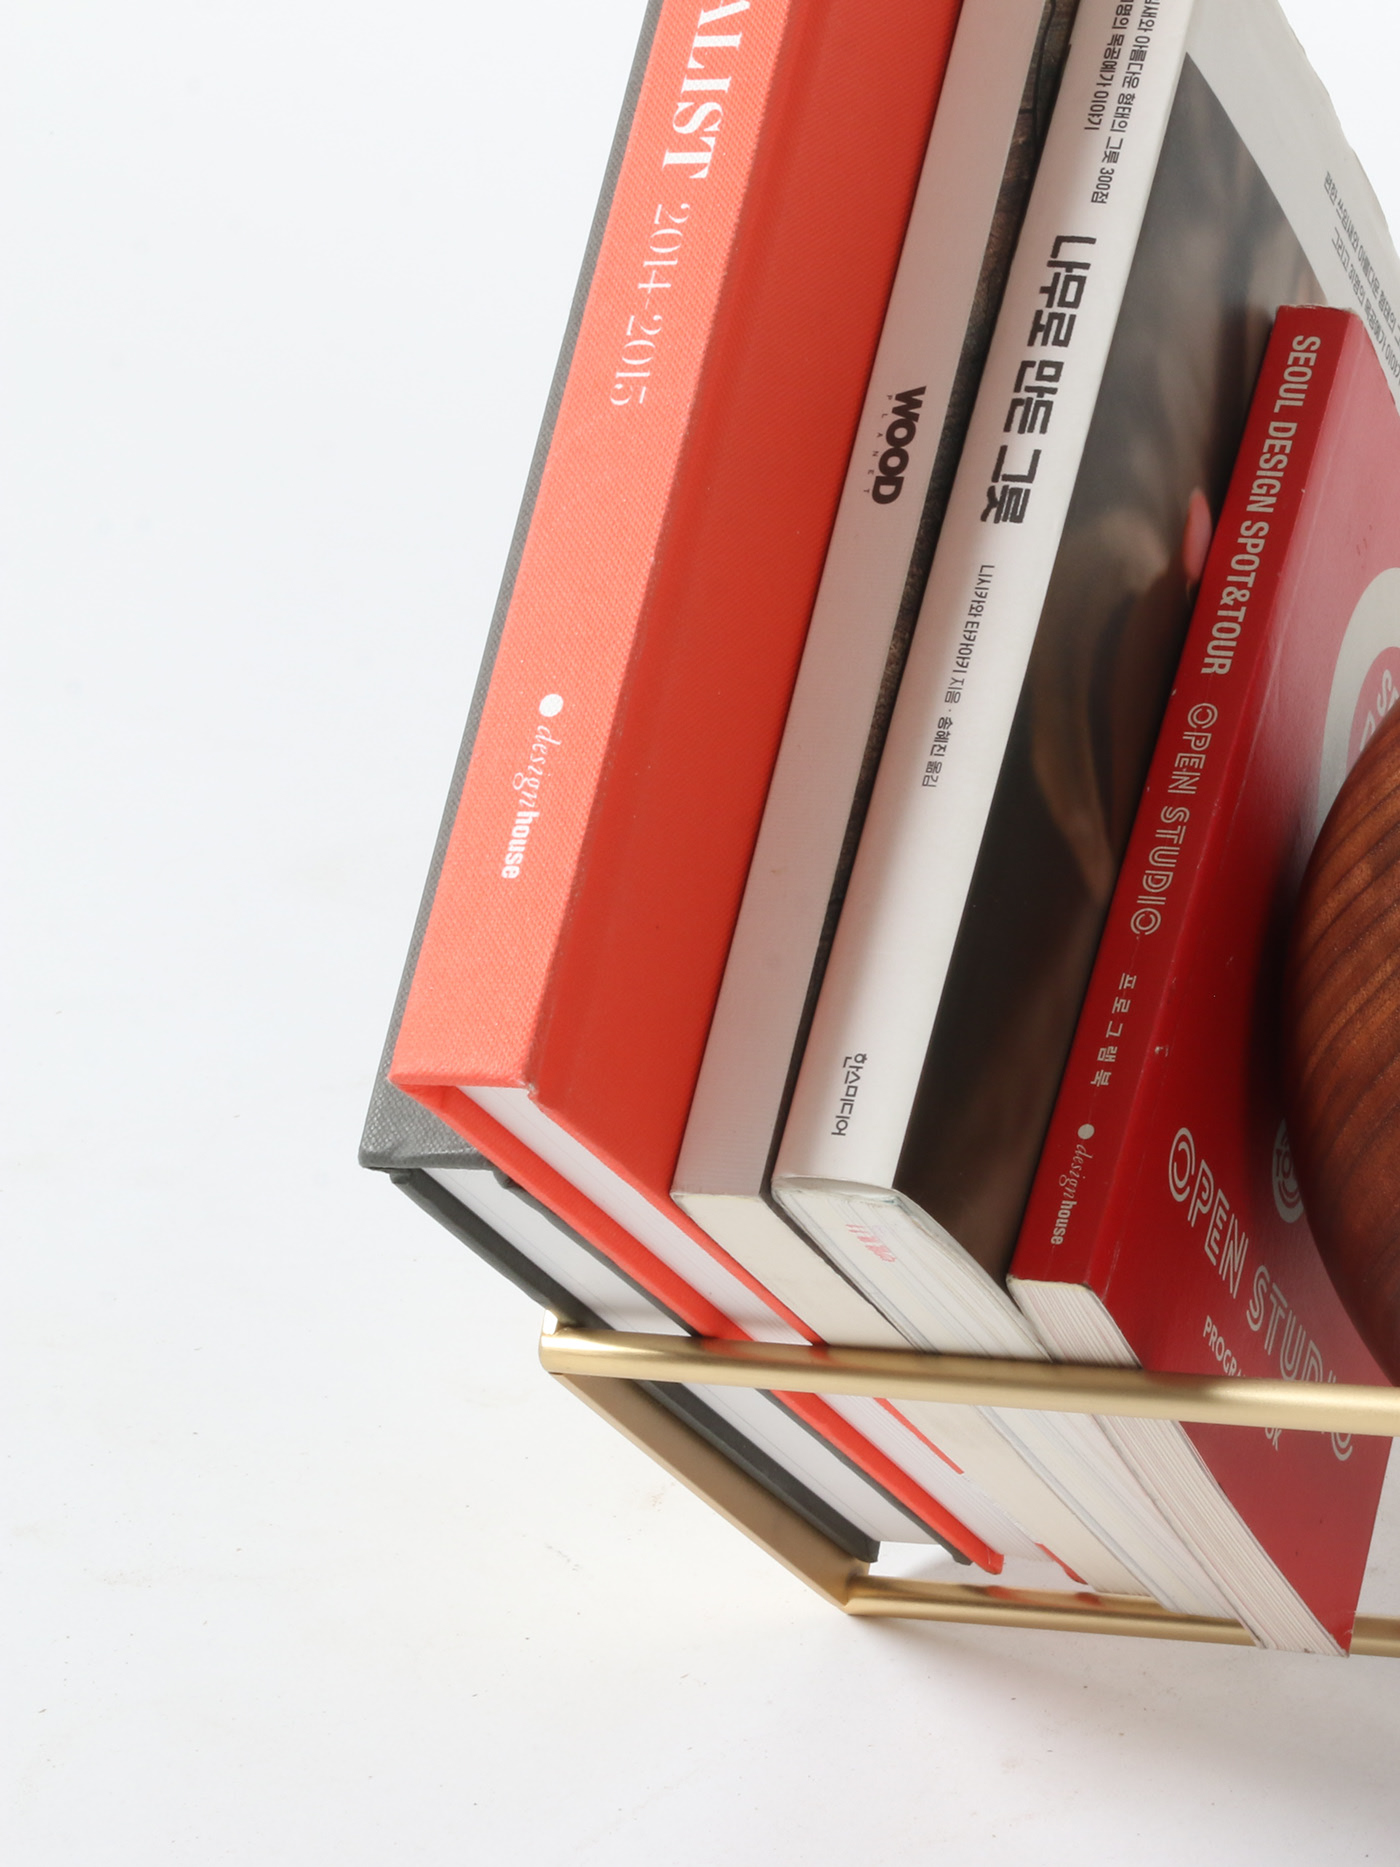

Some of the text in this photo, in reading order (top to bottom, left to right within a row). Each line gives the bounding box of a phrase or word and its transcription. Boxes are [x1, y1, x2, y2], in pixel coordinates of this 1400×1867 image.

[1096, 34, 1125, 86] 목공예가
[1122, 35, 1150, 89] 아름다운
[1084, 91, 1109, 130] 이야기
[1102, 136, 1123, 164] 그릇
[1110, 93, 1135, 132] 형태의
[1091, 167, 1114, 204] 300점
[1331, 227, 1350, 271] 그리고
[1357, 244, 1381, 299] 아름다운
[1378, 290, 1397, 334] 형태의
[609, 203, 691, 406] 2014-2015
[980, 235, 1096, 524] 나무로 만든 그릇
[871, 385, 927, 505] WOOD
[1200, 334, 1321, 676] SEOUL DESIGN SPOT&TOUR
[922, 564, 995, 788] 니시카와 타카아키 지음 송혜진 옮김
[1130, 702, 1218, 935] OPEN STUDIO
[831, 1053, 867, 1136] 한스미디어
[1168, 1127, 1248, 1299] OPEN
